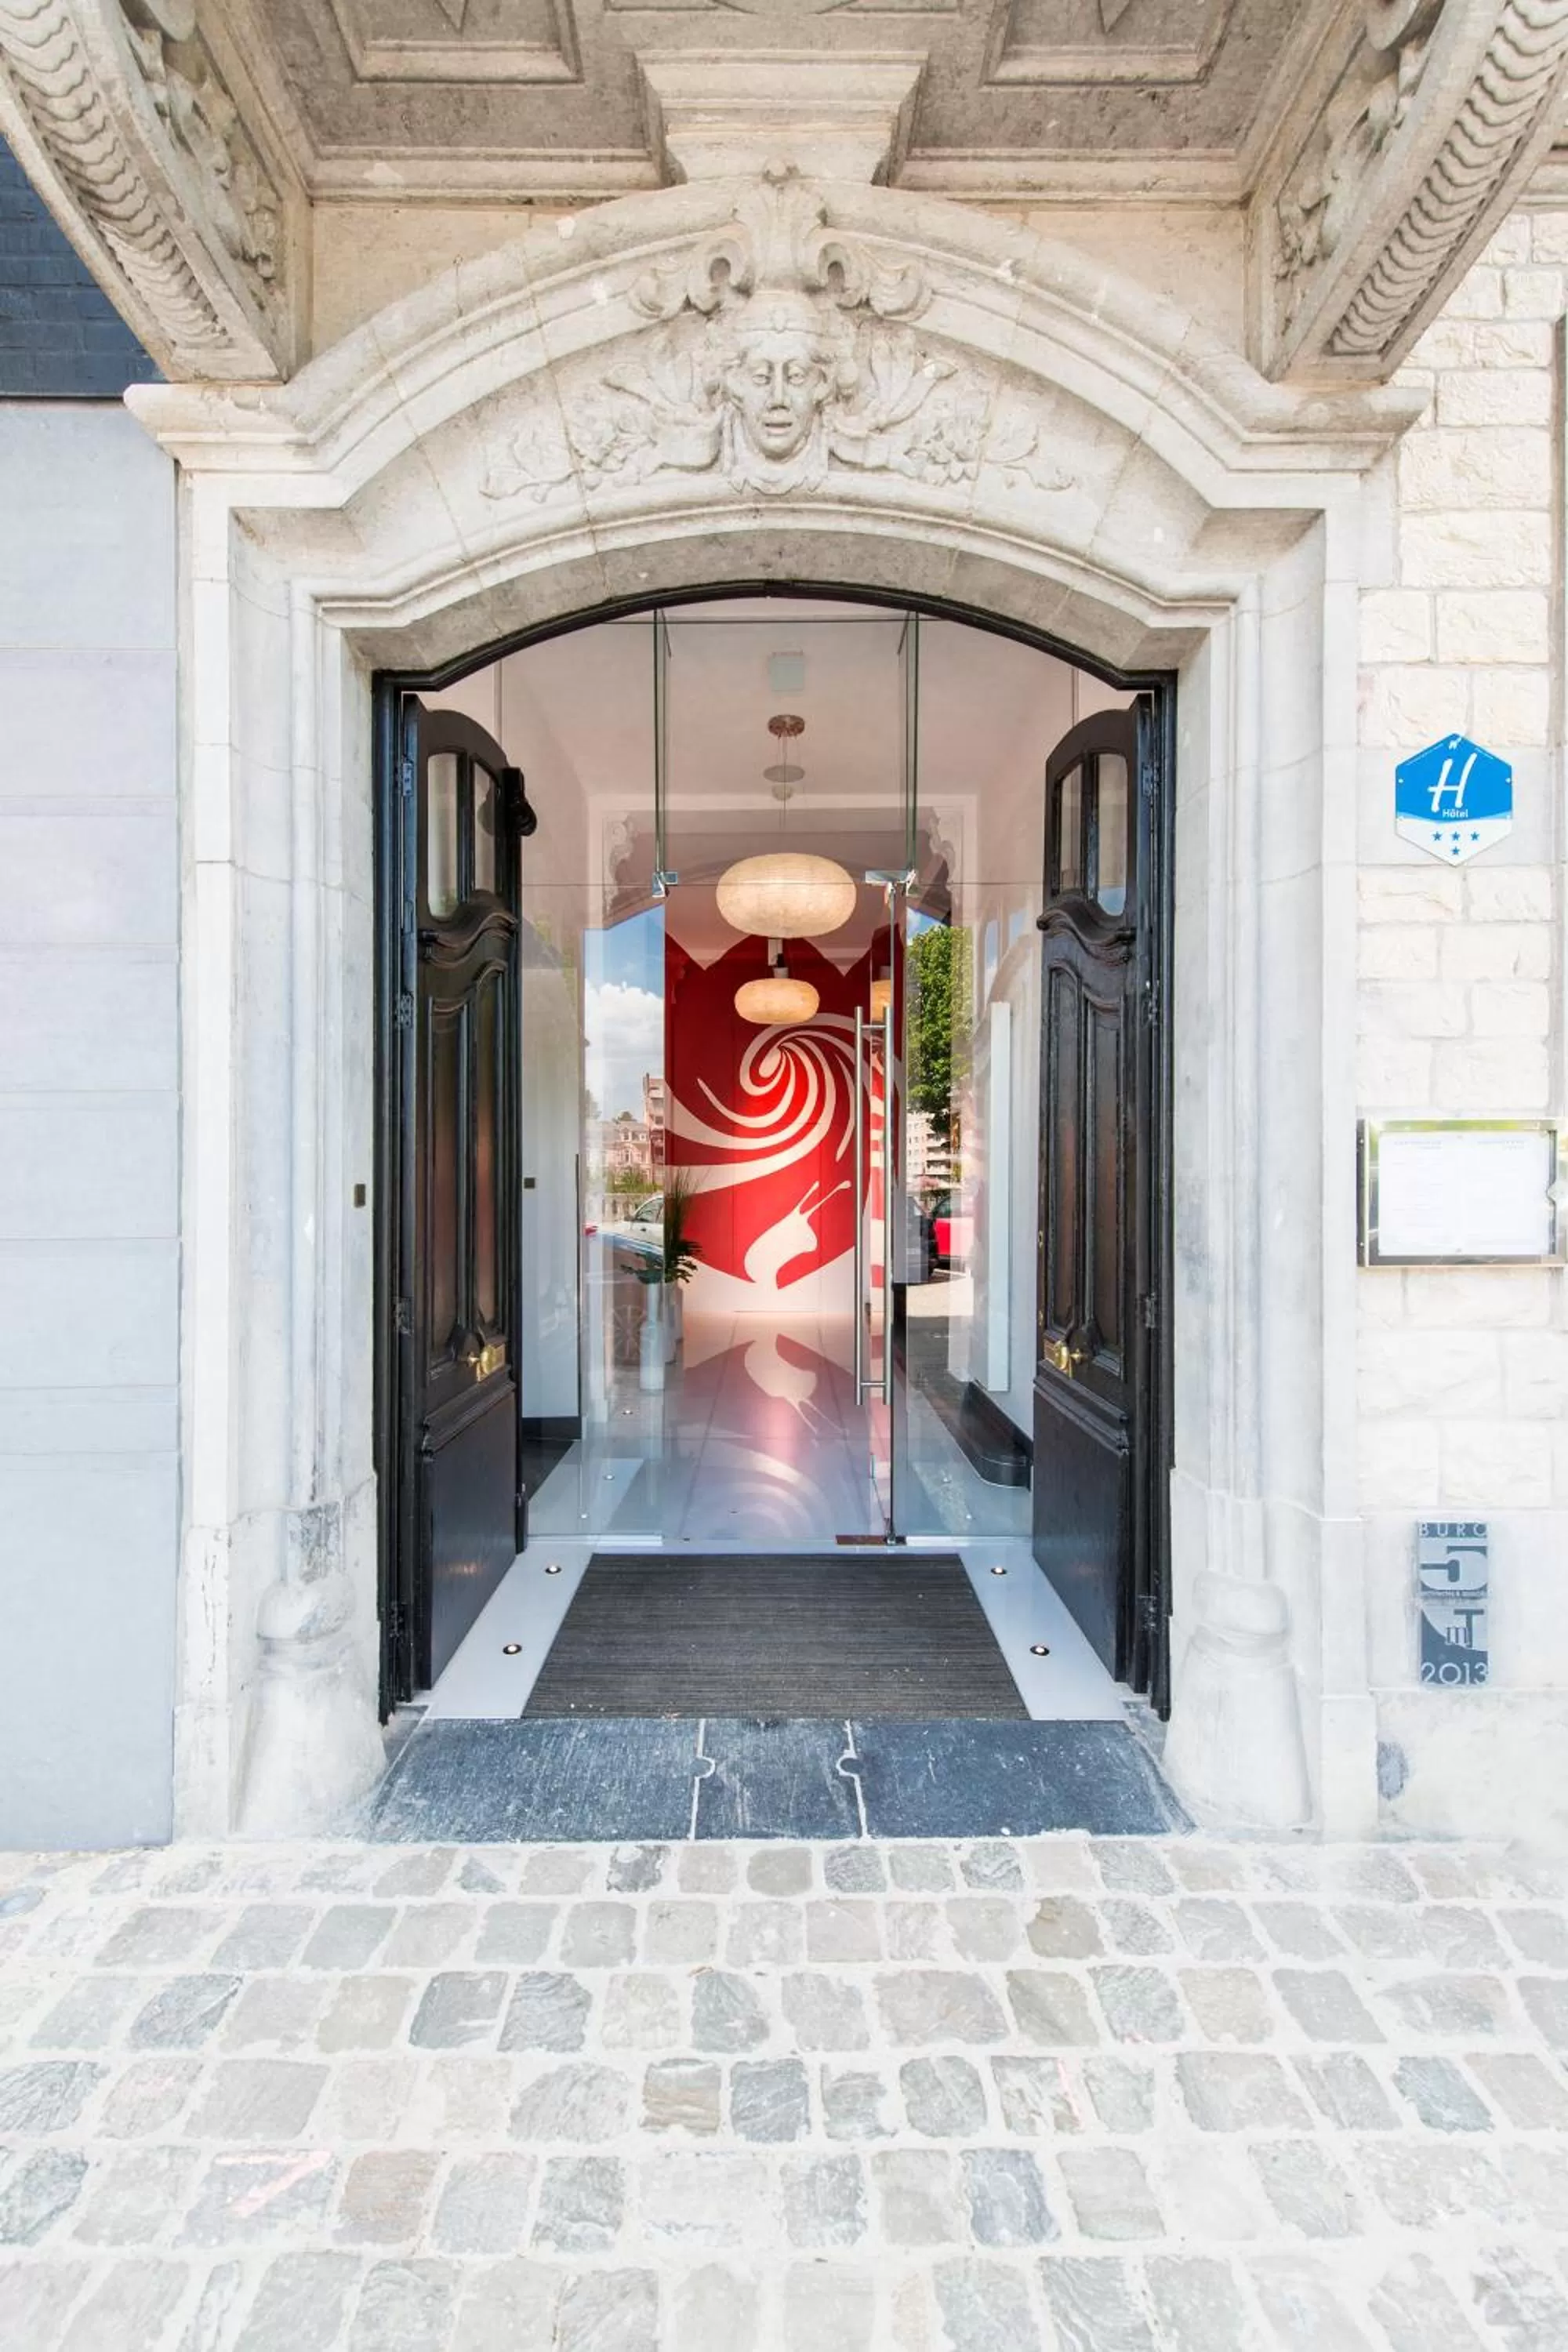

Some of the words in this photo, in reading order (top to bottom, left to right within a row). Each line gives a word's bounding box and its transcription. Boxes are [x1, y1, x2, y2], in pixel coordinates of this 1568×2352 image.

[1427, 752, 1478, 813] H
[1442, 808, 1468, 818] Hôtel
[1421, 1661, 1489, 1685] 2013
